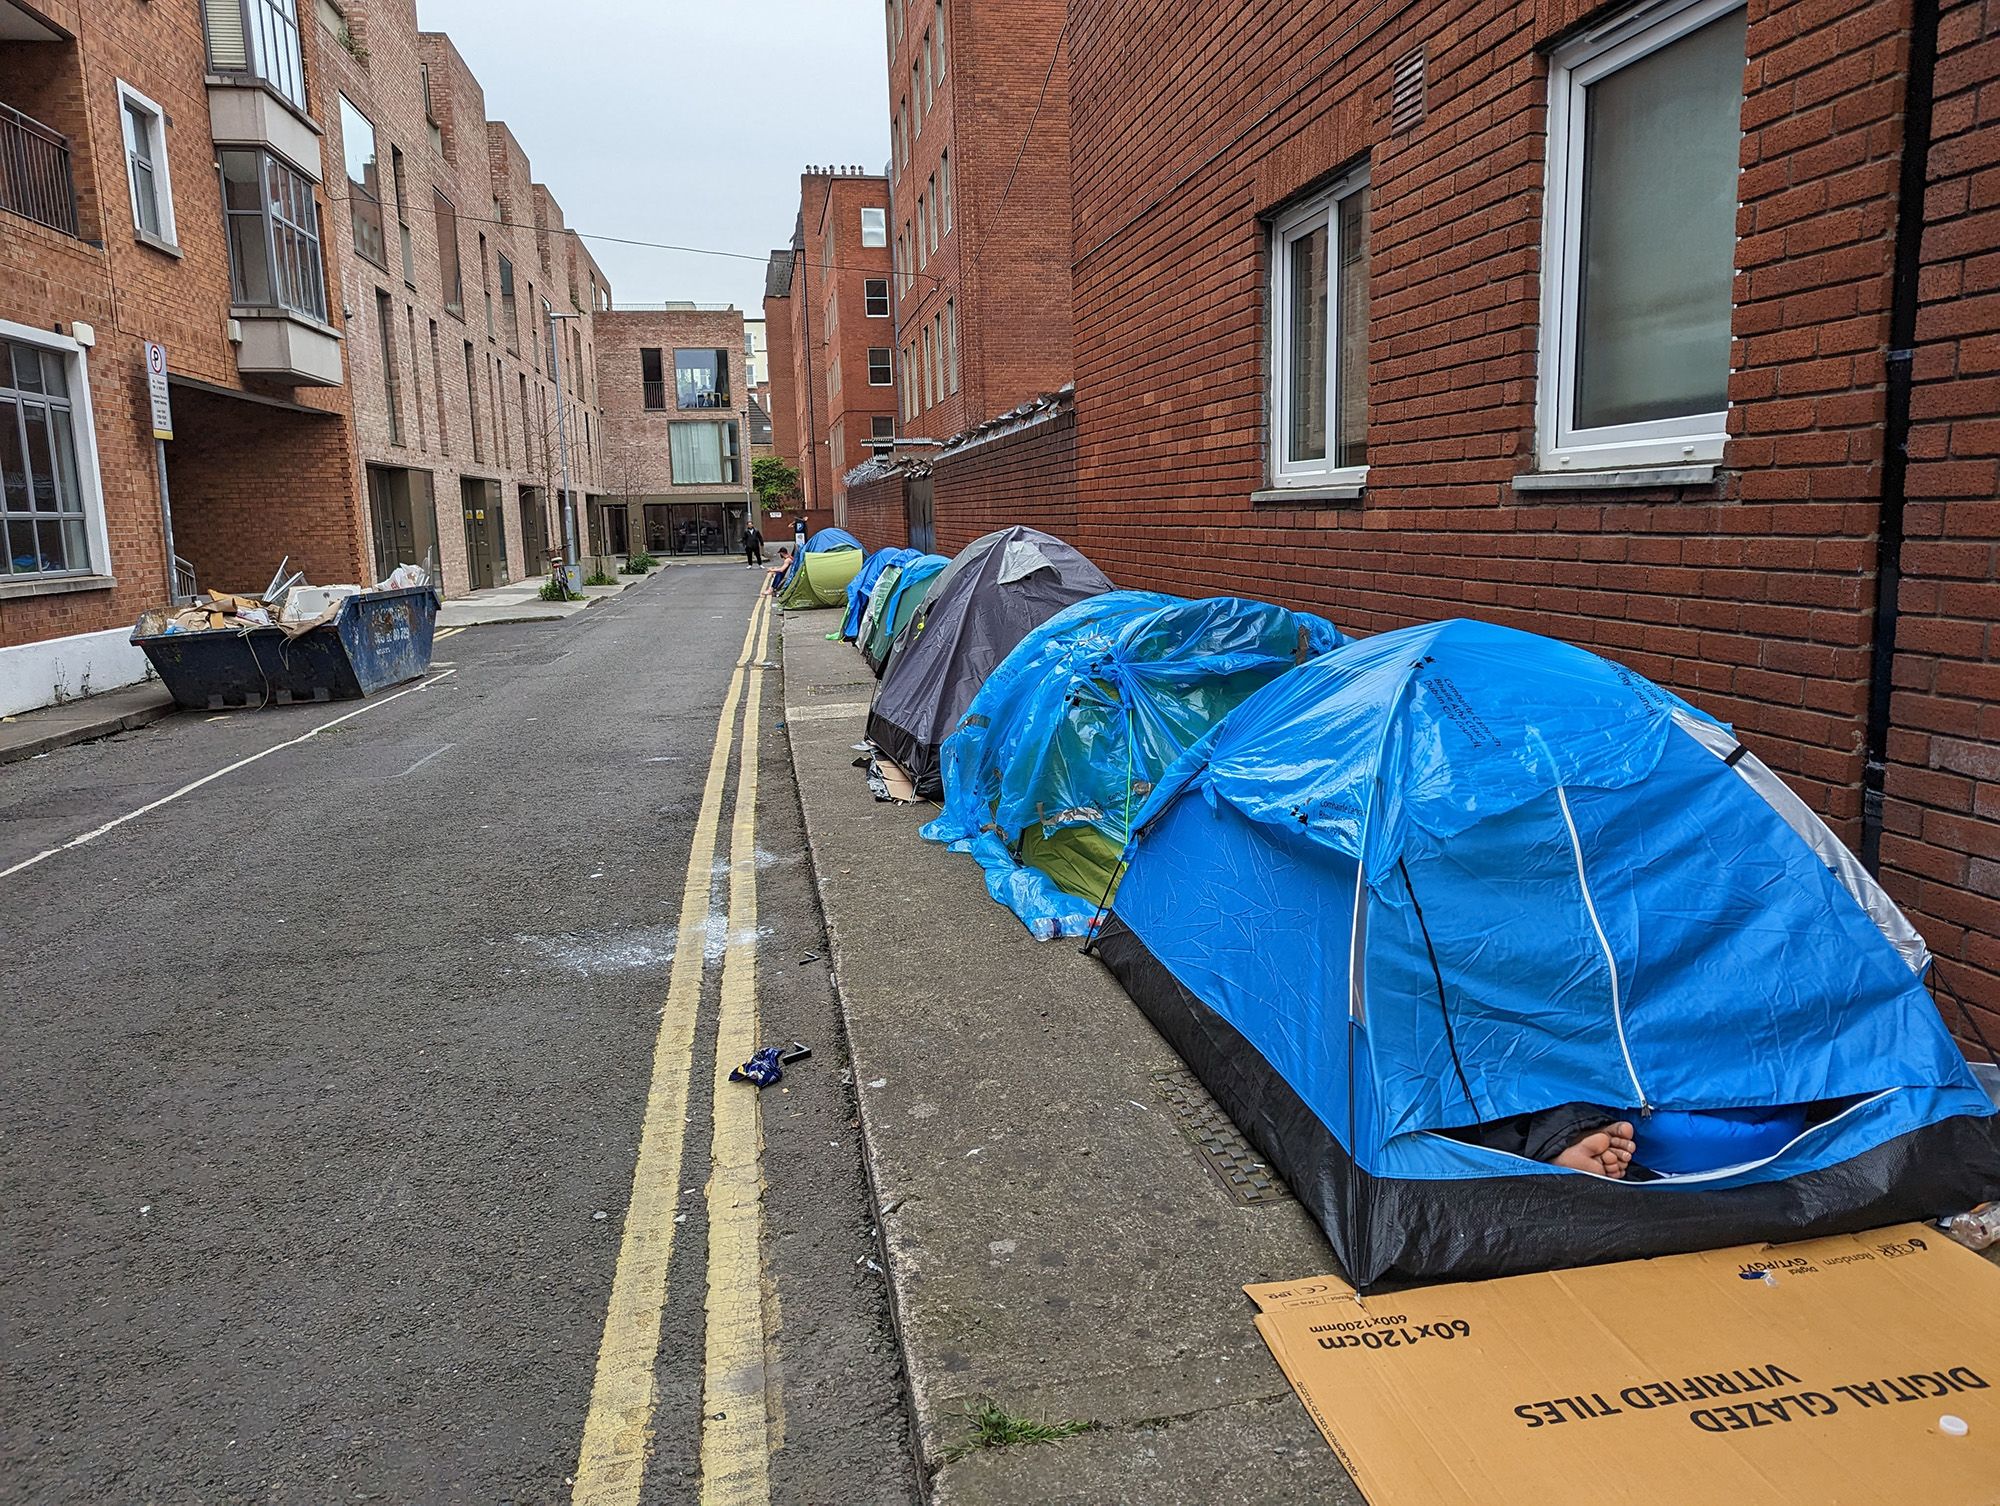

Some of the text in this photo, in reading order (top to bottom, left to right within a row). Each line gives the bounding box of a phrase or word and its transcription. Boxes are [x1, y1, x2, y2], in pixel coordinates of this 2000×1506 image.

[1617, 671, 1633, 685] City
[1631, 687, 1657, 717] Council
[1738, 1257, 1808, 1272] GVT/PGVT
[1789, 1266, 1819, 1275] Digital
[1823, 1252, 1876, 1266] Random
[1309, 1314, 1408, 1333] 600x1200mm
[1317, 1319, 1471, 1350] 60x120cm
[1513, 1364, 1803, 1428] VITRIFIED TILES
[1689, 1366, 1991, 1433] DIGITAL GLAZED
